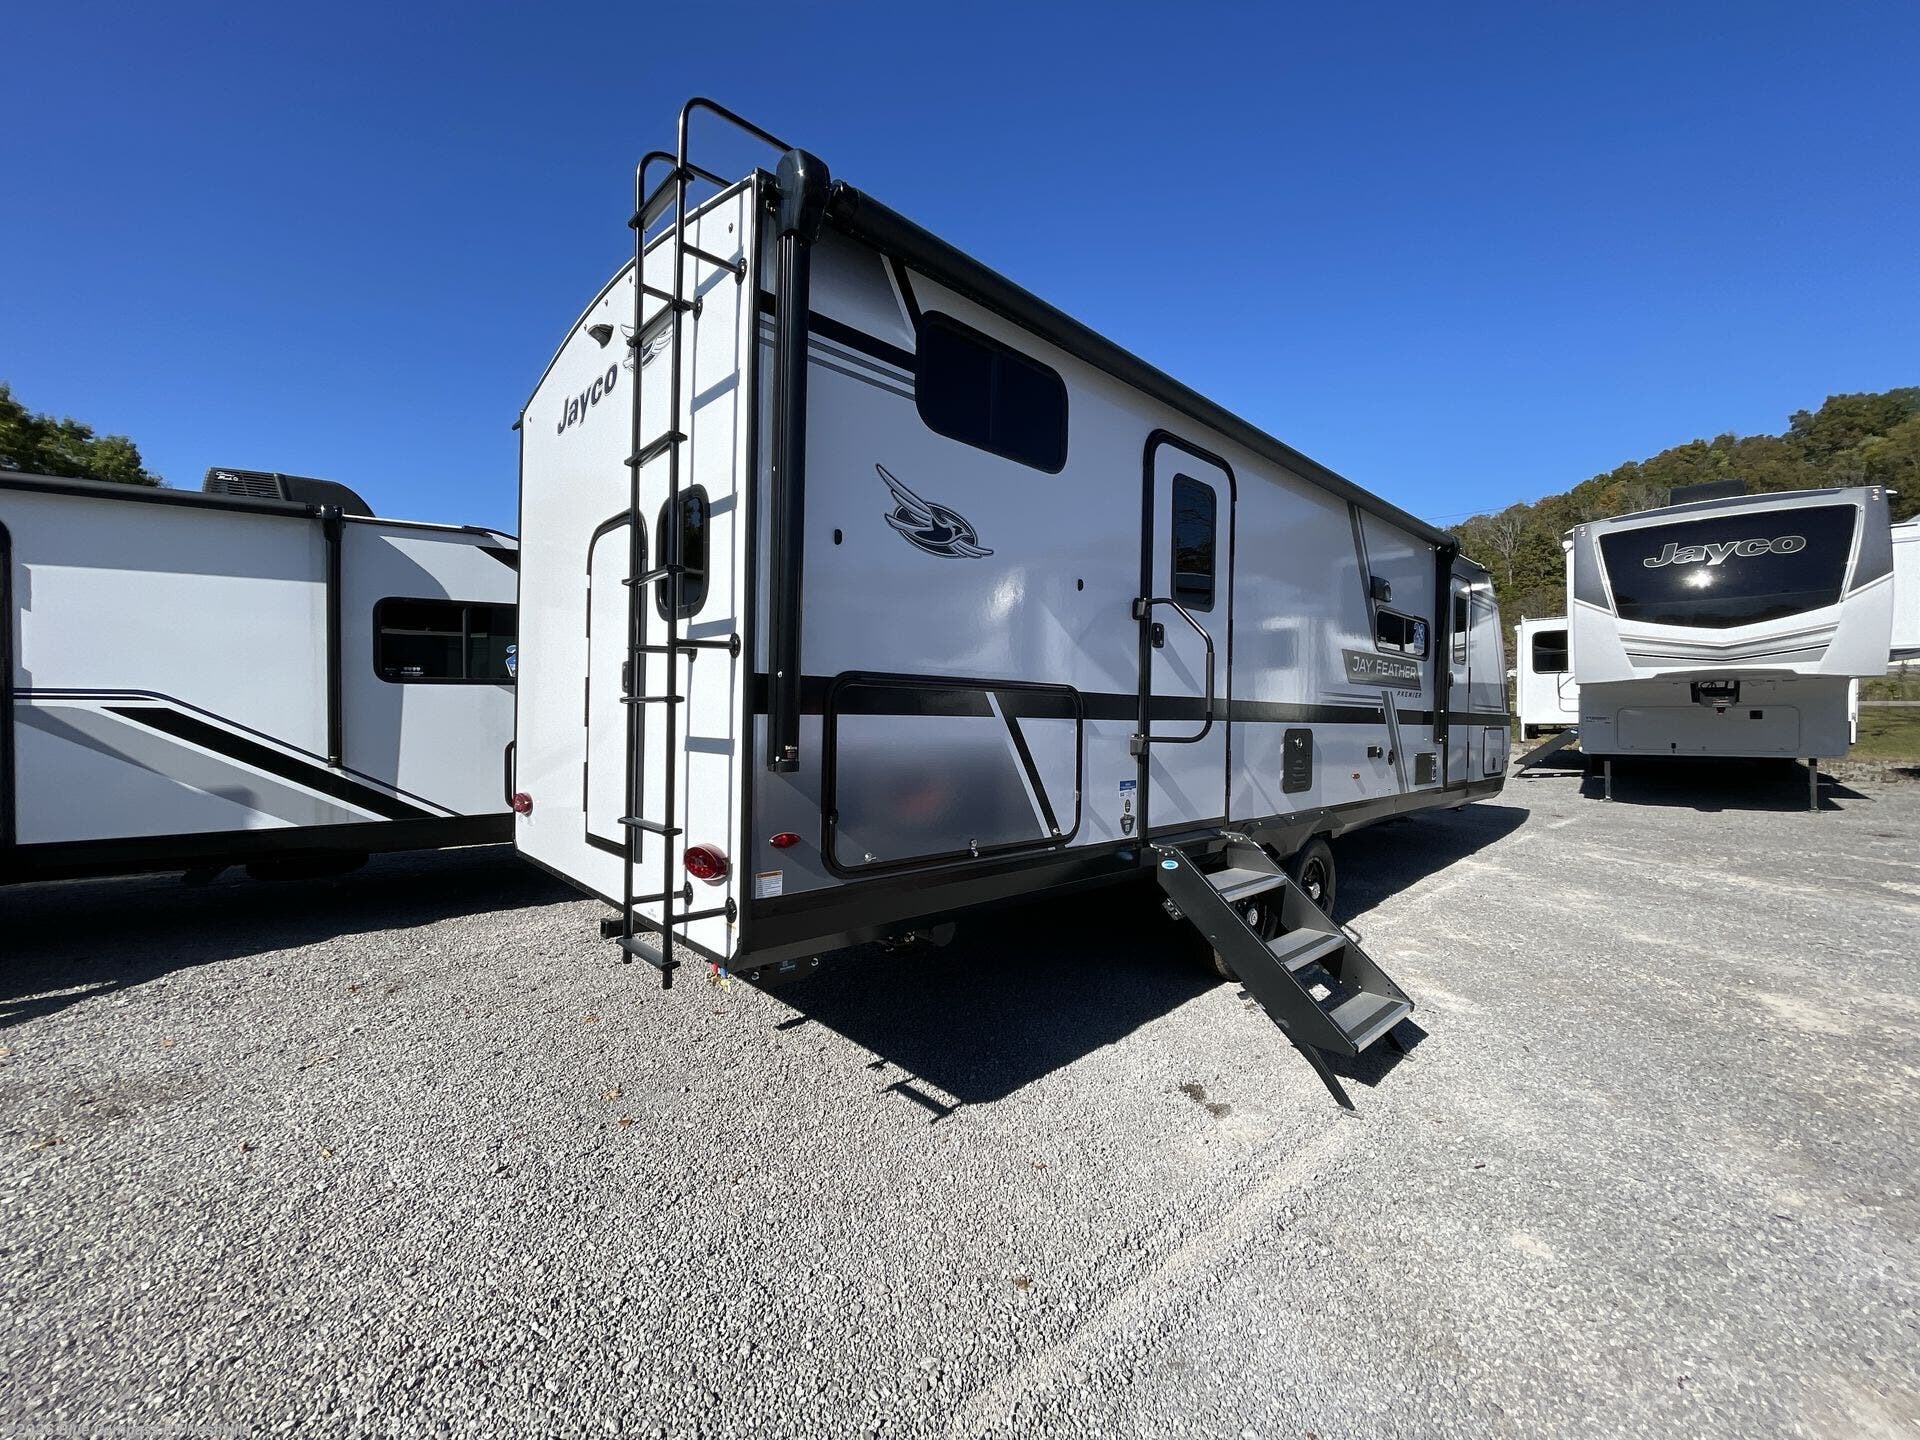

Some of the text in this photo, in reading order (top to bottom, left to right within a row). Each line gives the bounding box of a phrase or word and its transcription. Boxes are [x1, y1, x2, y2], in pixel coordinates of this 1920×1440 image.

[557, 363, 618, 434] Jayco
[1643, 535, 1807, 568] Jayco
[1353, 656, 1417, 679] JAY FEATHER
